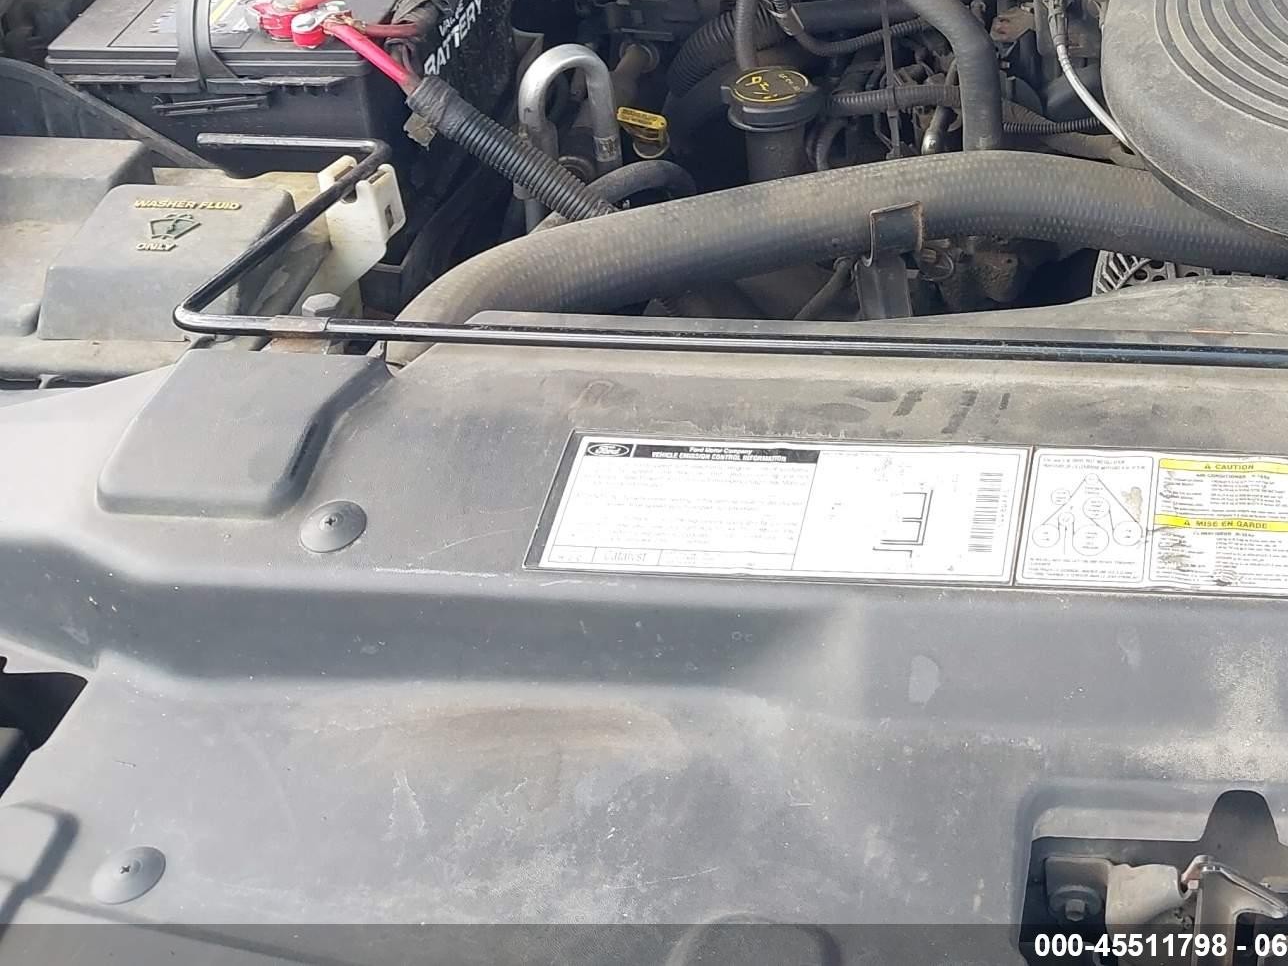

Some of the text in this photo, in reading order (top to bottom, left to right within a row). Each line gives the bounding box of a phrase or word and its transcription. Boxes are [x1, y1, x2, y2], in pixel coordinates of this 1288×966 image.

[134, 199, 241, 211] WASHER FLUID
[136, 242, 177, 252] ONLY
[1215, 463, 1254, 471] CAUTION
[1196, 520, 1268, 529] MISE EN GARDE
